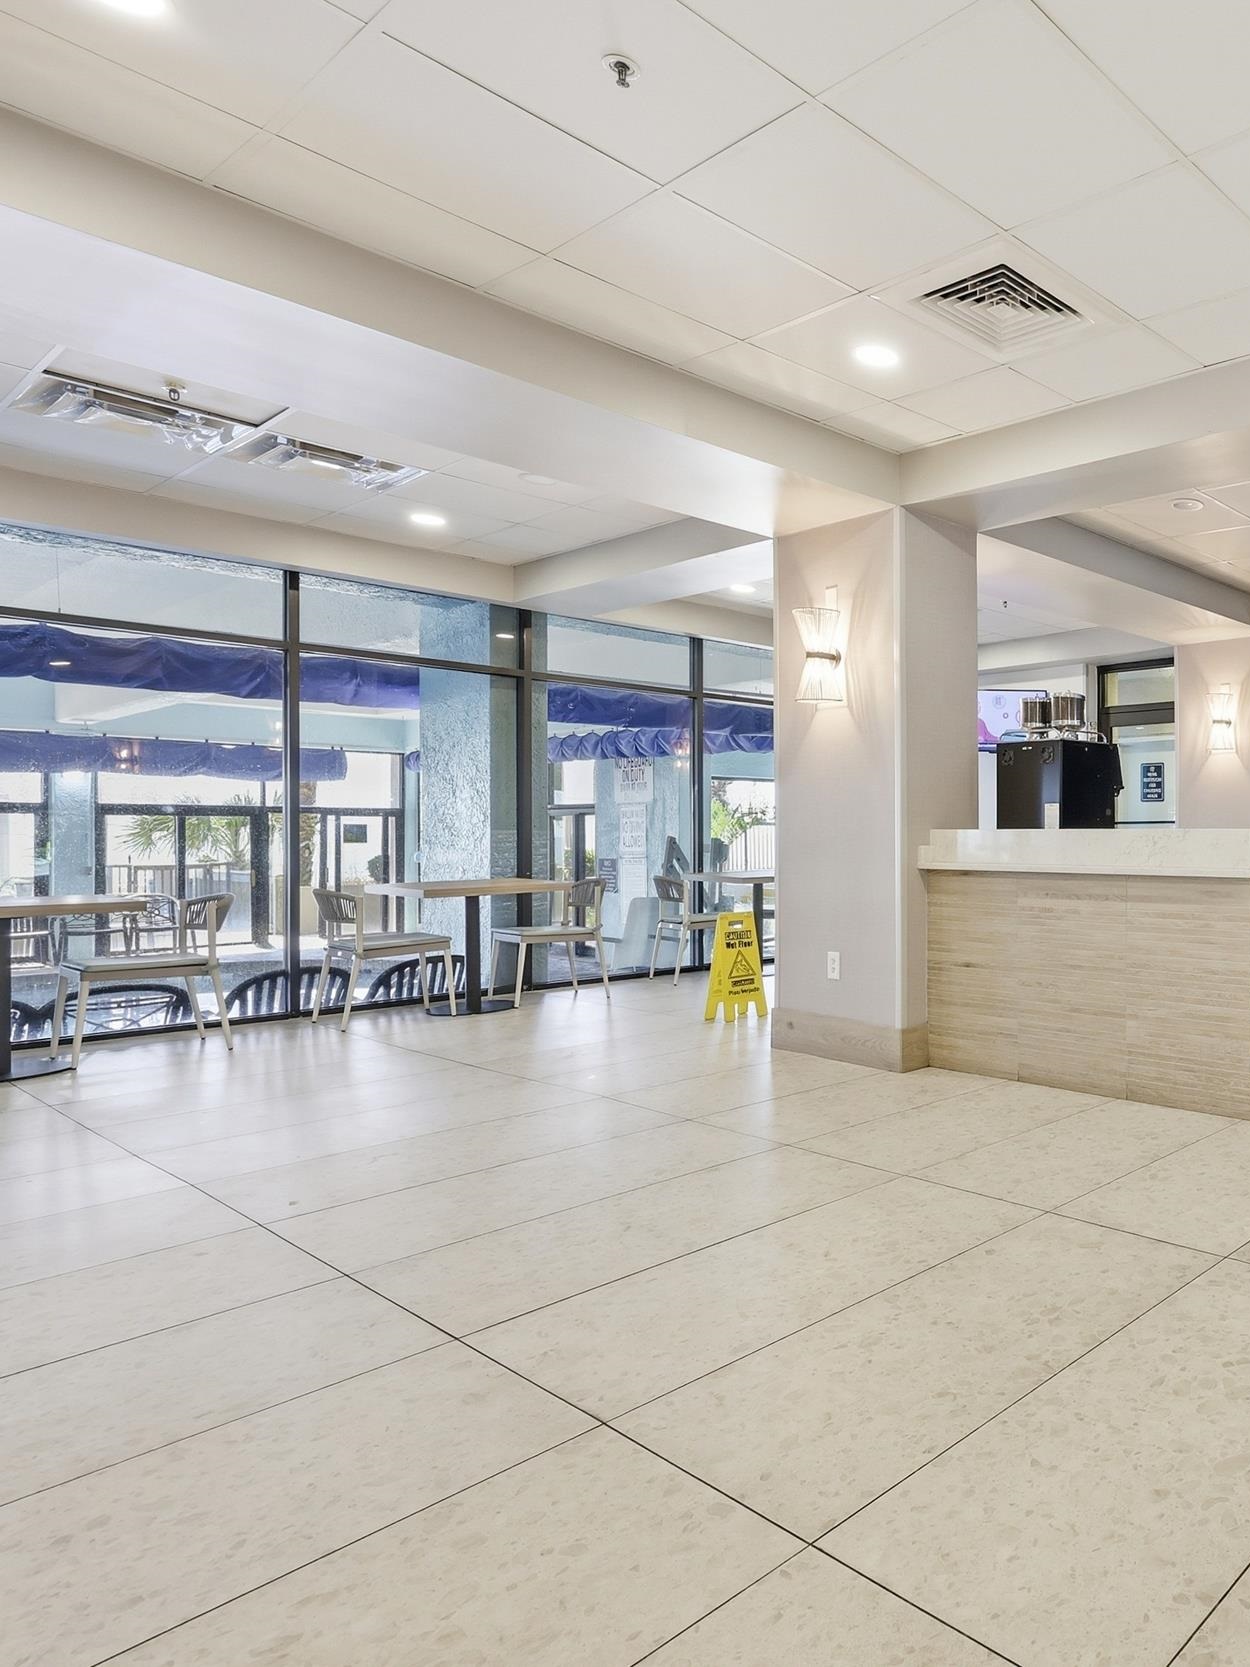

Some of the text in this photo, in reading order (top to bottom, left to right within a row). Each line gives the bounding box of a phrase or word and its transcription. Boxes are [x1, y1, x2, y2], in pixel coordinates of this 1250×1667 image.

[630, 768, 645, 782] DUTY
[726, 940, 753, 949] Wet Floor
